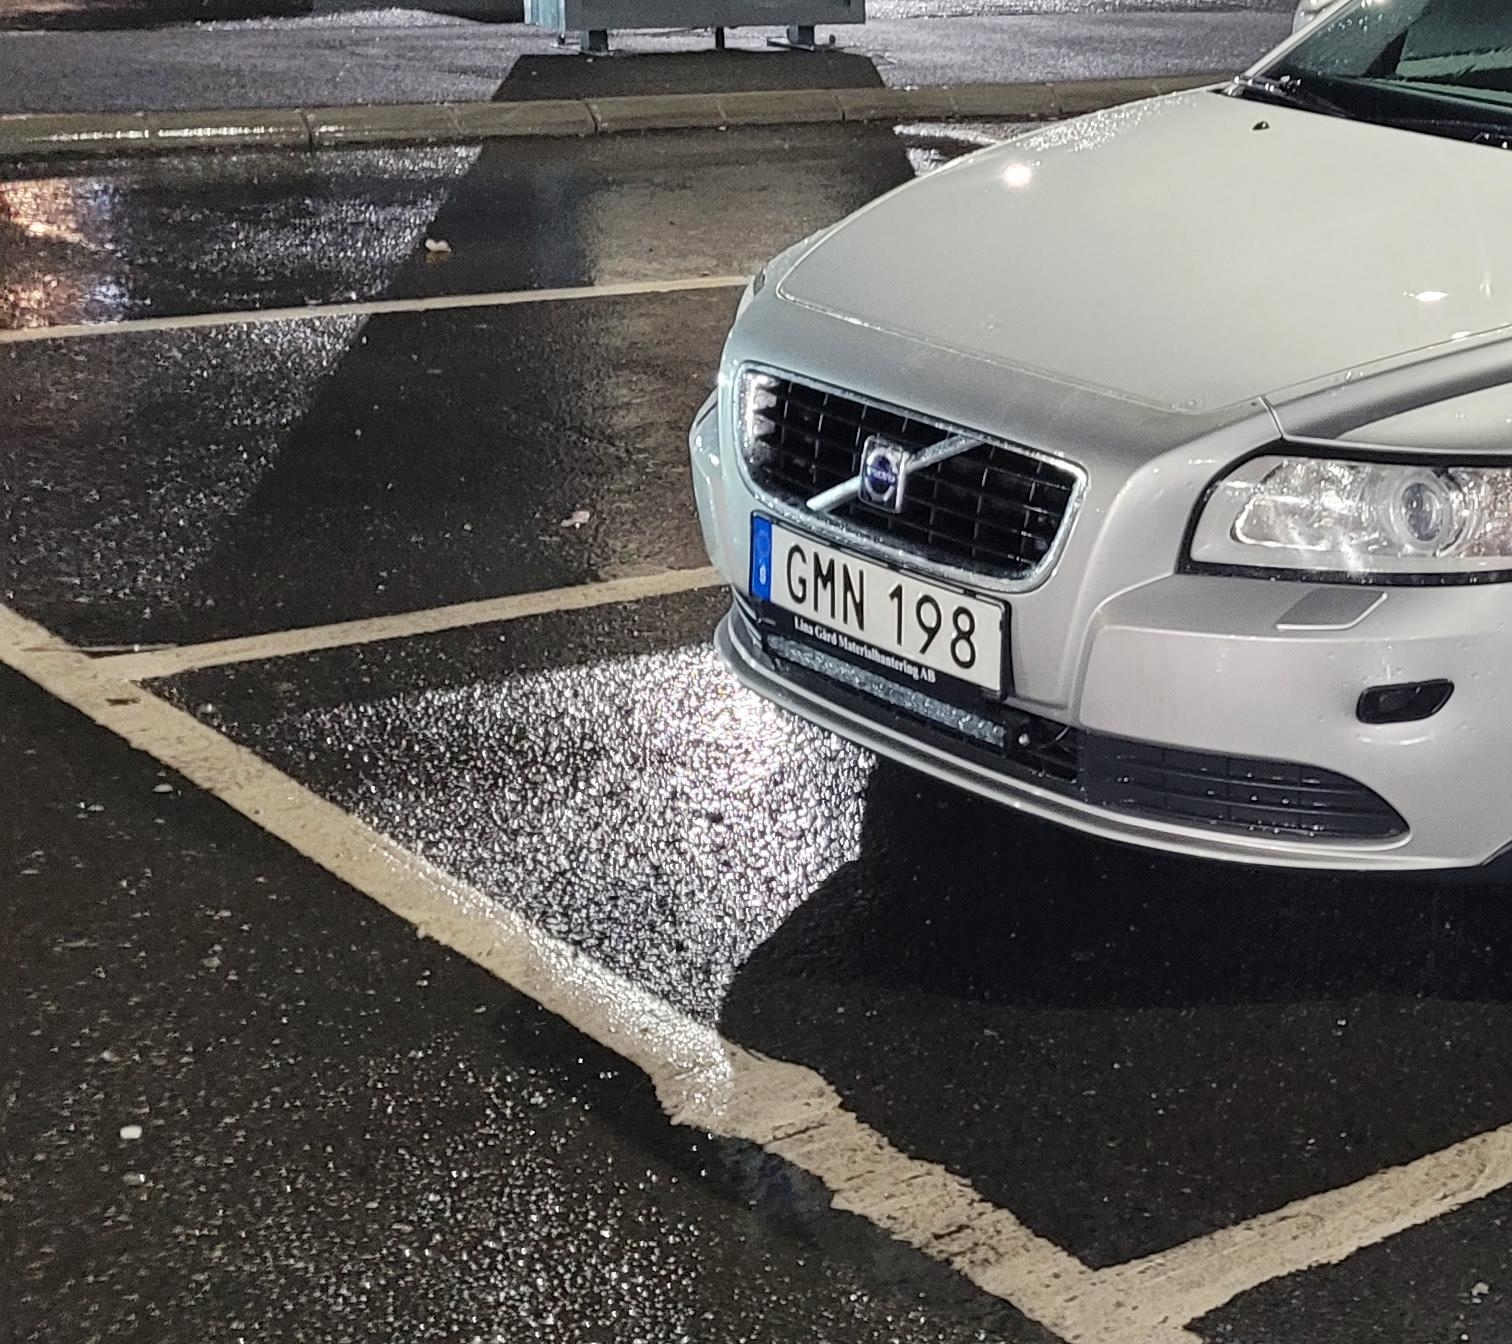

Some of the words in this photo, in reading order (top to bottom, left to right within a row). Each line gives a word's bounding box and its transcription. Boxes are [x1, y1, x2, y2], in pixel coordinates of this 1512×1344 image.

[786, 544, 865, 631] GMN
[889, 583, 977, 669] 198
[839, 634, 919, 681] Materialhantering
